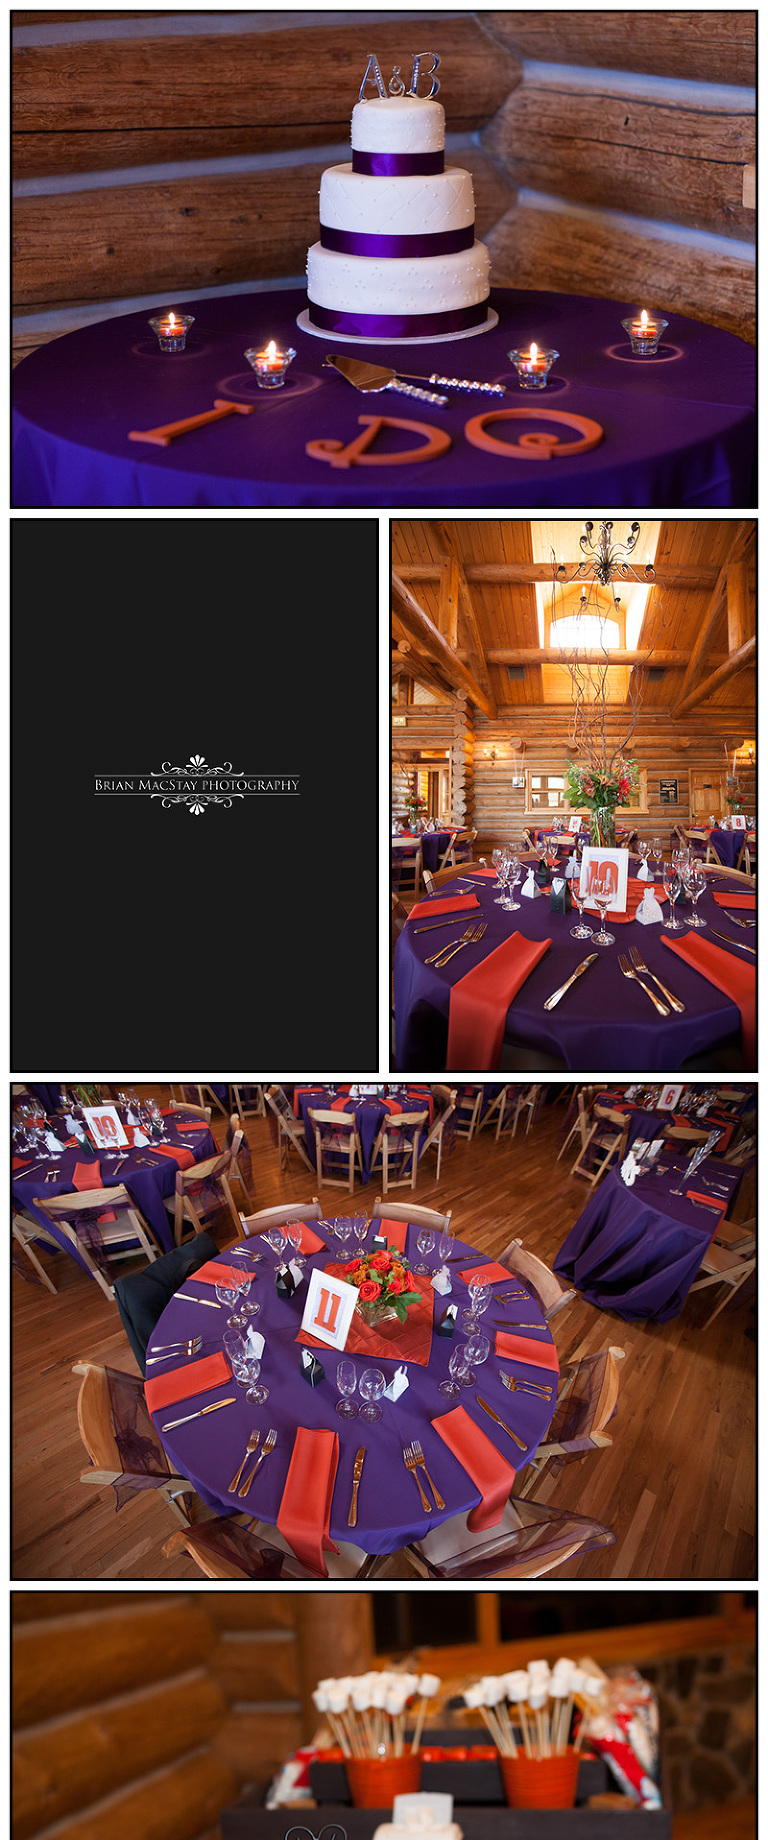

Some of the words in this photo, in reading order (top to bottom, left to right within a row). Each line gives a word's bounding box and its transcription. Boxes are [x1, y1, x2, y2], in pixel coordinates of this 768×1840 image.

[128, 400, 254, 446] I
[306, 407, 604, 469] DO
[589, 860, 619, 897] 10
[664, 1088, 676, 1105] 6
[91, 1115, 118, 1139] 10
[313, 1287, 342, 1334] 11
